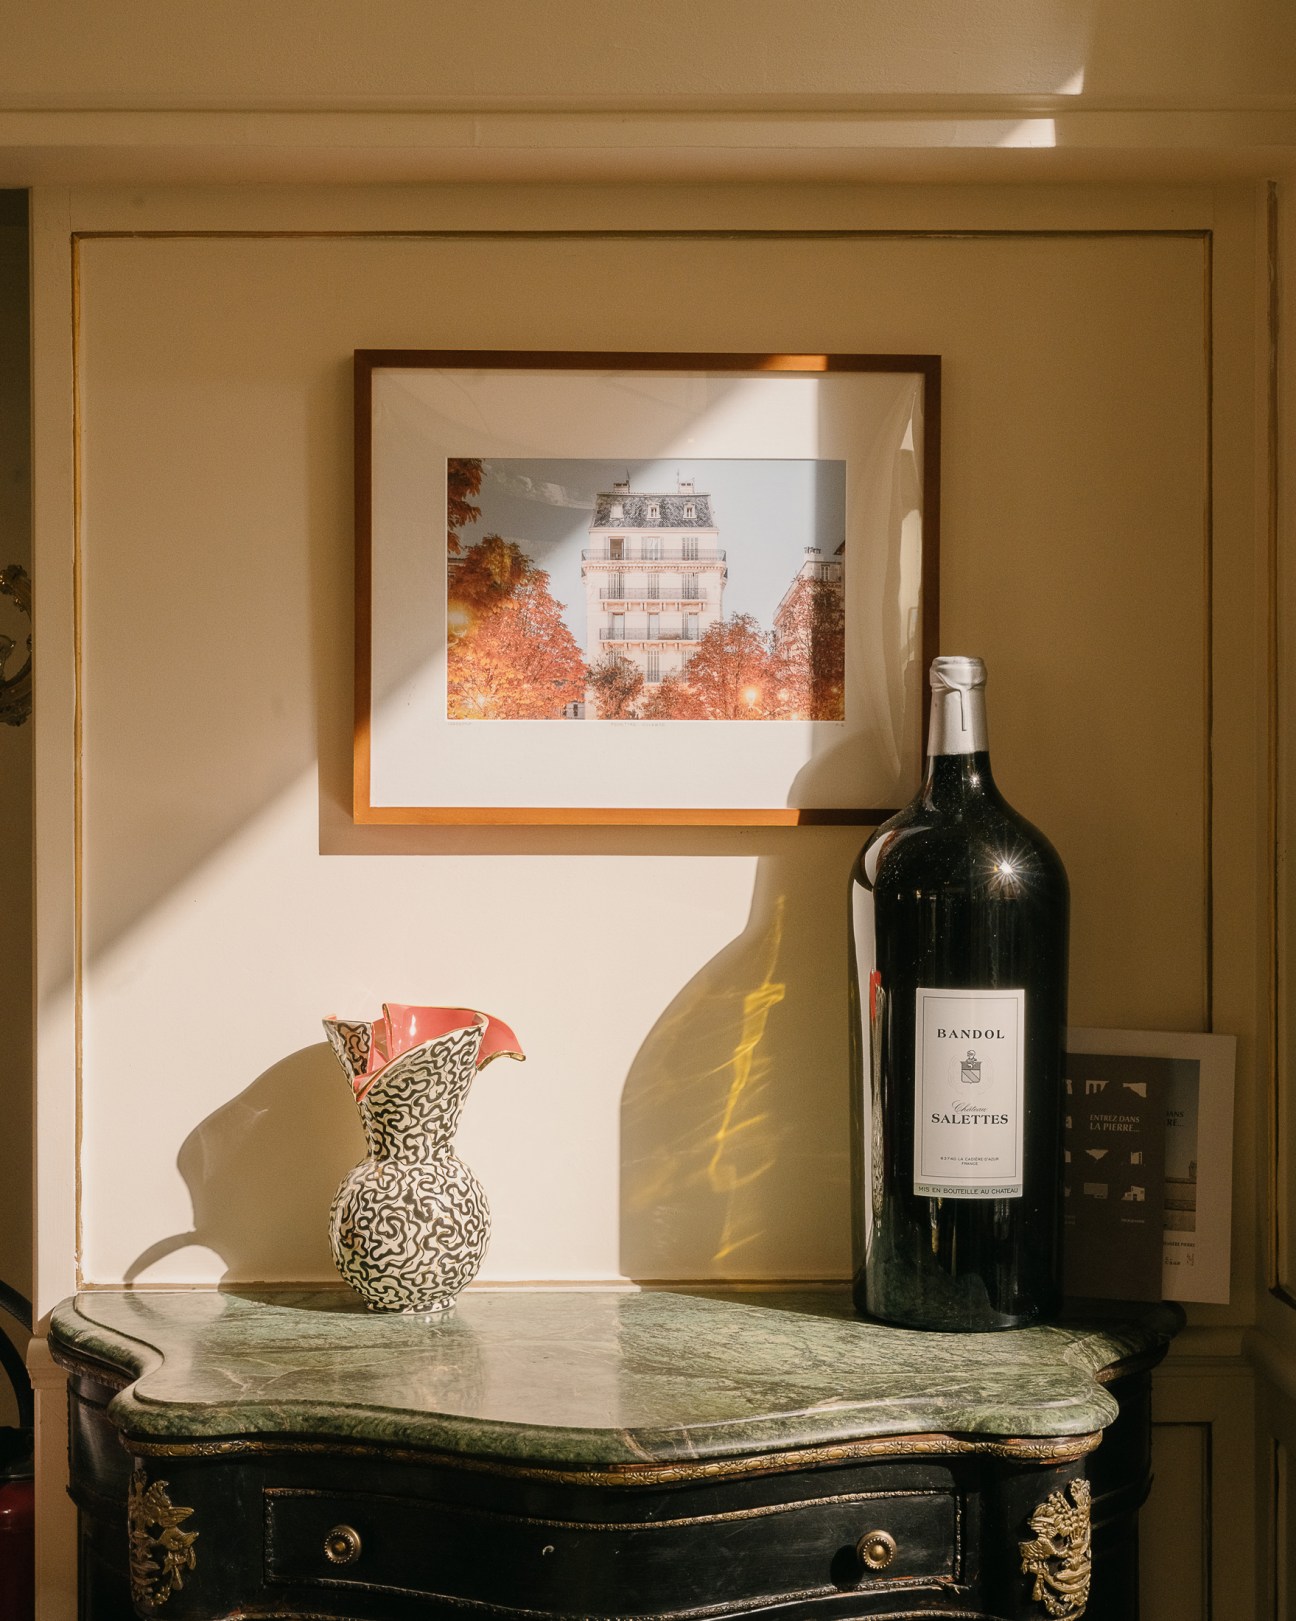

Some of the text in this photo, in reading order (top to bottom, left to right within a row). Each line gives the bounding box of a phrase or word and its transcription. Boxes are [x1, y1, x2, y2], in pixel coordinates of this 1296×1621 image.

[937, 1028, 1005, 1040] BANDOL
[931, 1113, 1009, 1125] SALETTES
[1089, 1114, 1140, 1123] ENTREZ DANS
[1089, 1121, 1101, 1131] LA
[943, 1187, 978, 1195] BOUTEILLE
